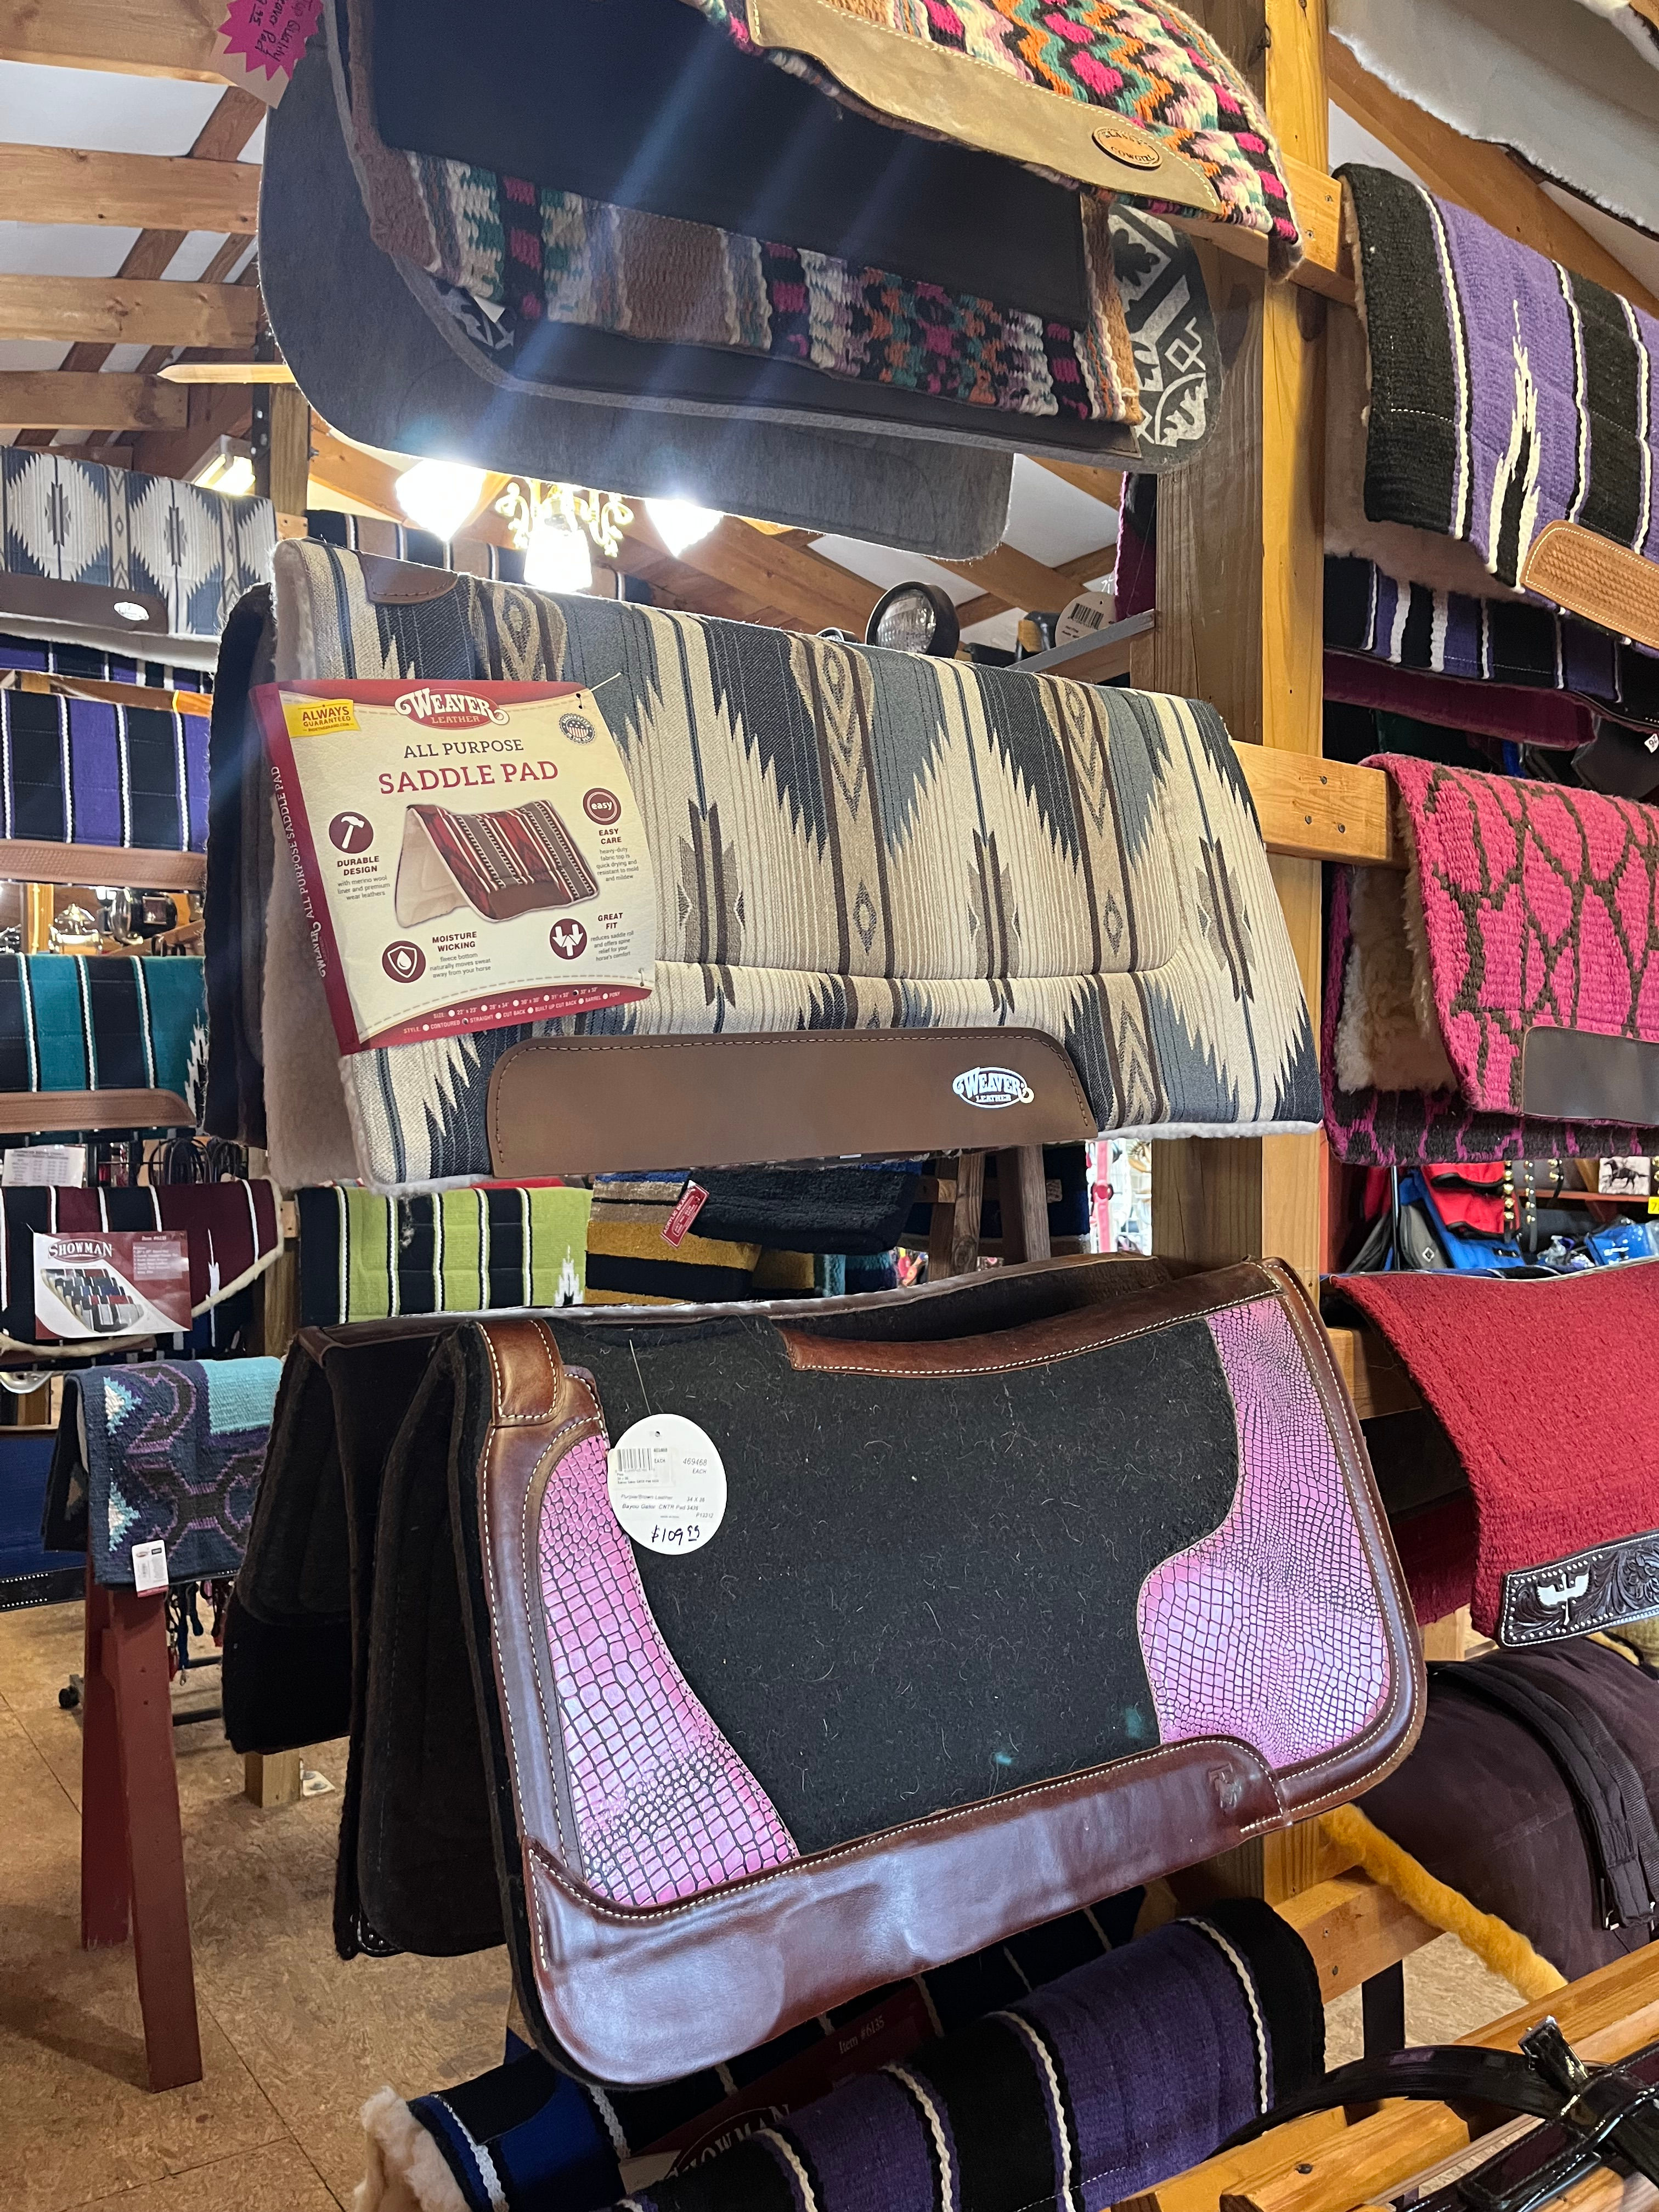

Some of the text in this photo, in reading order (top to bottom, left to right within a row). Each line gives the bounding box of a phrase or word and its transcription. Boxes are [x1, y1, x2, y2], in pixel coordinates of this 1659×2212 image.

[394, 687, 510, 725] WEAVER
[303, 706, 349, 721] ALWAYS
[303, 716, 351, 727] GUARANTEED
[430, 715, 481, 725] LEATHER
[404, 739, 524, 758] ALL PURPOSE
[379, 761, 558, 795] SADDLE PAD
[591, 802, 612, 810] easy
[599, 828, 619, 836] EASY
[271, 766, 315, 919] ALL PURPOSE SADDLE PAD
[337, 856, 380, 867] DURABLE
[343, 865, 377, 876] DESIGN
[364, 883, 390, 891] premium
[598, 912, 623, 921] GREAT
[432, 932, 477, 943] MOISTURE
[311, 921, 327, 978] WEAVER
[437, 941, 476, 952] WICKING
[430, 1020, 460, 1029] CONTOURED
[470, 1015, 493, 1023] STRAIGHT
[952, 1067, 1034, 1103] WEAVER
[975, 1094, 1012, 1103] LEATHER
[663, 1210, 678, 1234] ACRYLIC
[48, 1242, 112, 1257] SHOWMAN
[683, 1458, 707, 1466] 469468
[838, 2015, 885, 2055] Item #6135
